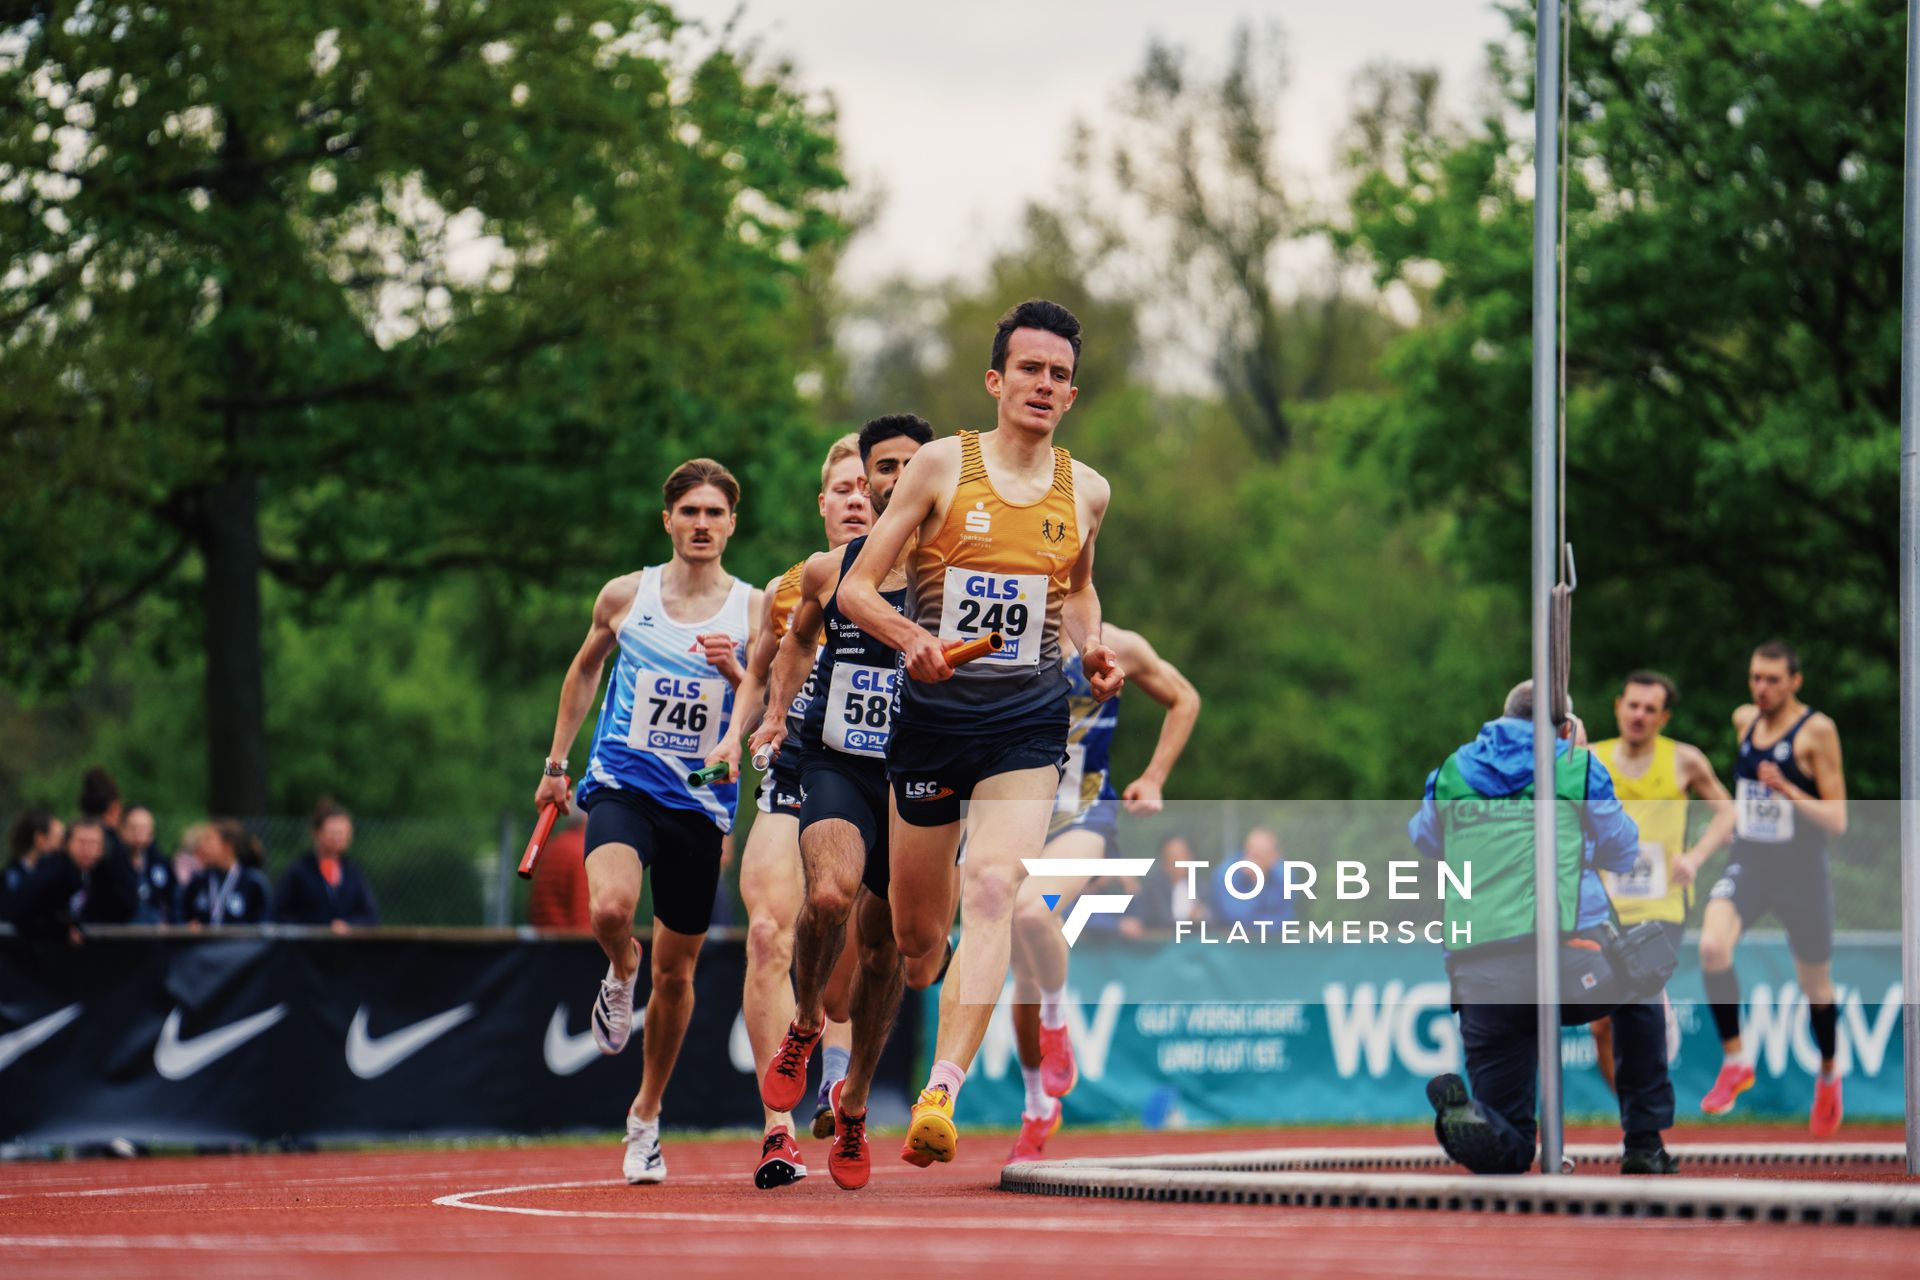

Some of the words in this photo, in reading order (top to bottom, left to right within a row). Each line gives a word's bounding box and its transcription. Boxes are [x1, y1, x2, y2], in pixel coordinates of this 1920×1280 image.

[957, 599, 1028, 636] 249
[840, 622, 859, 630] Spark
[840, 631, 860, 639] Leipzig
[648, 697, 708, 732] 746
[669, 735, 698, 748] PLAN
[905, 781, 937, 796] LSC
[1486, 795, 1535, 811] PLA
[1324, 980, 1462, 1079] WG
